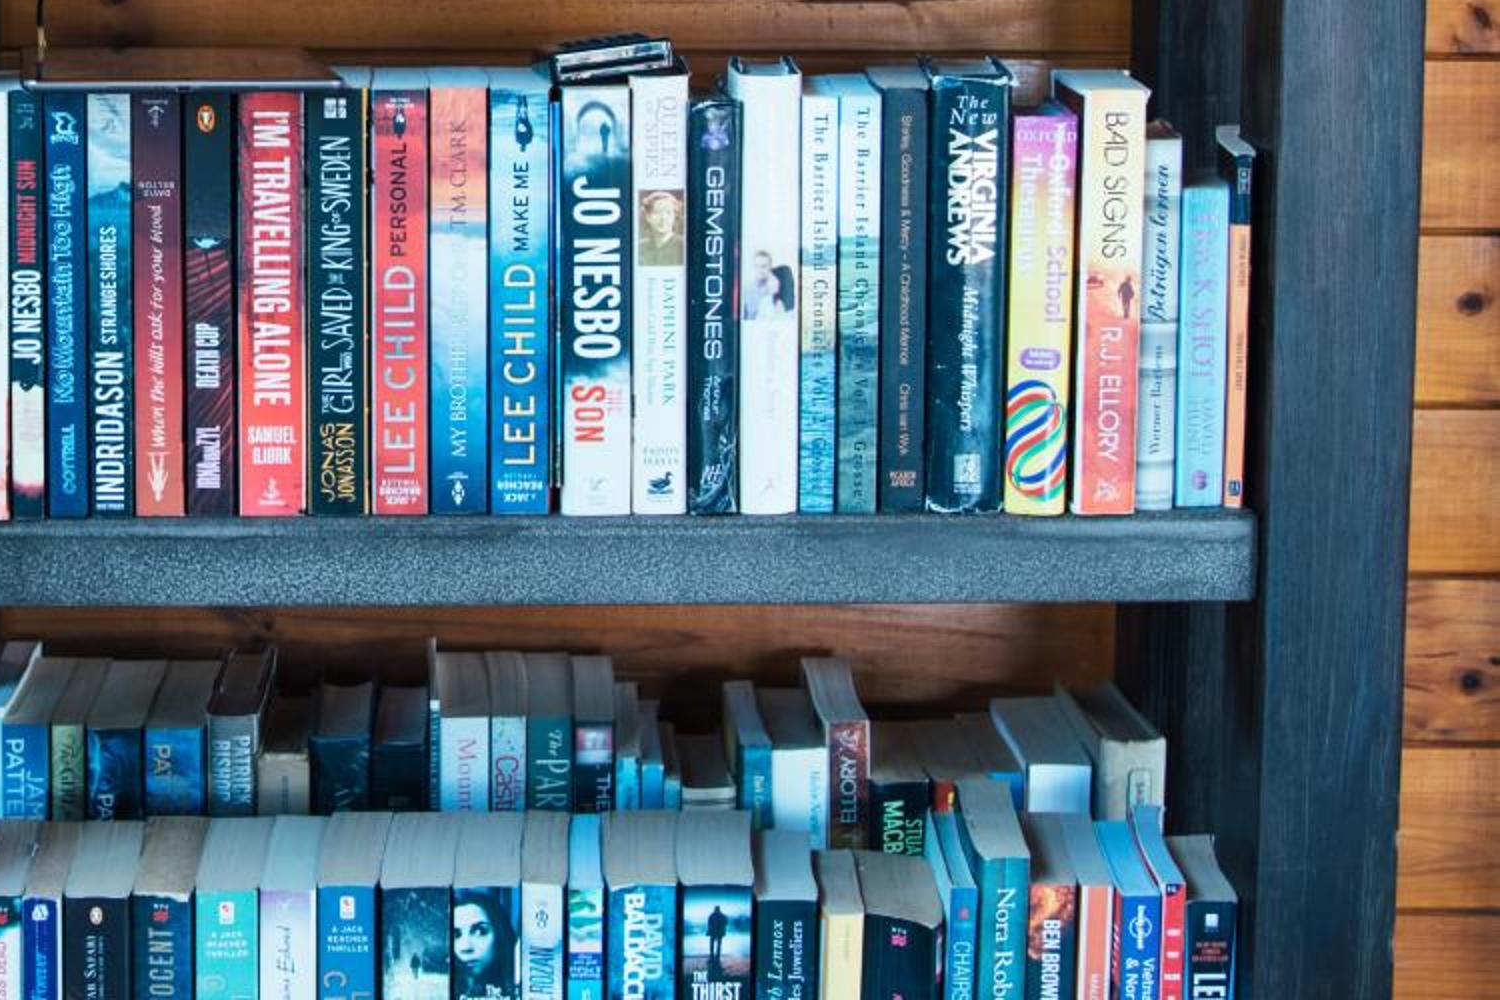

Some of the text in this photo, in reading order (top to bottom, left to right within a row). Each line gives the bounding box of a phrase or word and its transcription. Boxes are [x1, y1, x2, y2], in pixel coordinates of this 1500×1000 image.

[813, 113, 829, 136] The
[854, 106, 871, 129] The
[948, 108, 997, 125] New
[956, 95, 989, 109] The
[449, 119, 468, 188] CLARK
[644, 120, 660, 179] SPIES
[656, 95, 678, 178] QUEEN
[1103, 111, 1130, 167] BAD
[50, 165, 77, 217] High
[320, 136, 352, 212] SWEDEN
[389, 144, 409, 257] PERSONAL
[813, 153, 829, 212] Barrier
[854, 147, 870, 210] Barrier
[899, 153, 911, 206] Goodness
[946, 127, 971, 266] ANDREWS
[971, 128, 998, 265] VIRGINIA
[17, 161, 37, 265] MIDNIGHT SUN
[512, 162, 529, 252] MAKE ME
[52, 222, 73, 261] Too
[253, 110, 292, 406] I'M TRAVELLING ALONE
[321, 224, 353, 269] KING
[572, 175, 621, 359] JO NESBO
[703, 166, 724, 360] GEMSTONES
[813, 218, 829, 272] Island
[854, 216, 869, 270] Island
[12, 269, 42, 333] NESBO
[99, 226, 119, 345] STRANGE SHORES
[1043, 244, 1066, 324] School
[1147, 231, 1170, 321] Betrügen
[52, 263, 75, 368] Mountain
[144, 205, 167, 449] When the hills ask for your blood
[321, 288, 355, 350] SAVED
[661, 277, 677, 407] DAPHNE PARK
[812, 279, 828, 368] Chronicles
[13, 339, 42, 365] JO
[195, 323, 221, 388] DEATH CUP
[383, 265, 416, 474] LEE CHILD
[503, 263, 536, 466] LEE CHILD
[957, 285, 979, 433] Midnight Whispers
[55, 373, 75, 404] No
[323, 364, 355, 414] GIRL
[571, 385, 606, 442] SON
[1098, 326, 1121, 462] R.J. ELLORY
[95, 350, 125, 501] INDRIDASON
[247, 425, 297, 445] SAMUEL
[451, 427, 468, 457] MY
[1149, 402, 1163, 455] Werner
[62, 423, 77, 494] COTTRELL
[320, 422, 337, 503] JONAS
[337, 422, 356, 503] JONASSON
[232, 735, 251, 806] PATRICK
[549, 729, 563, 757] The
[839, 756, 857, 824] ELLORY
[643, 913, 663, 980] DAVID
[995, 887, 1016, 943] Nora
[1042, 919, 1061, 949] BEN
[84, 935, 97, 979] SAFARI
[148, 928, 175, 1000] OCENT
[766, 919, 783, 982] Lennox
[787, 920, 805, 984] Juweliers
[691, 981, 742, 1000] THIRST
